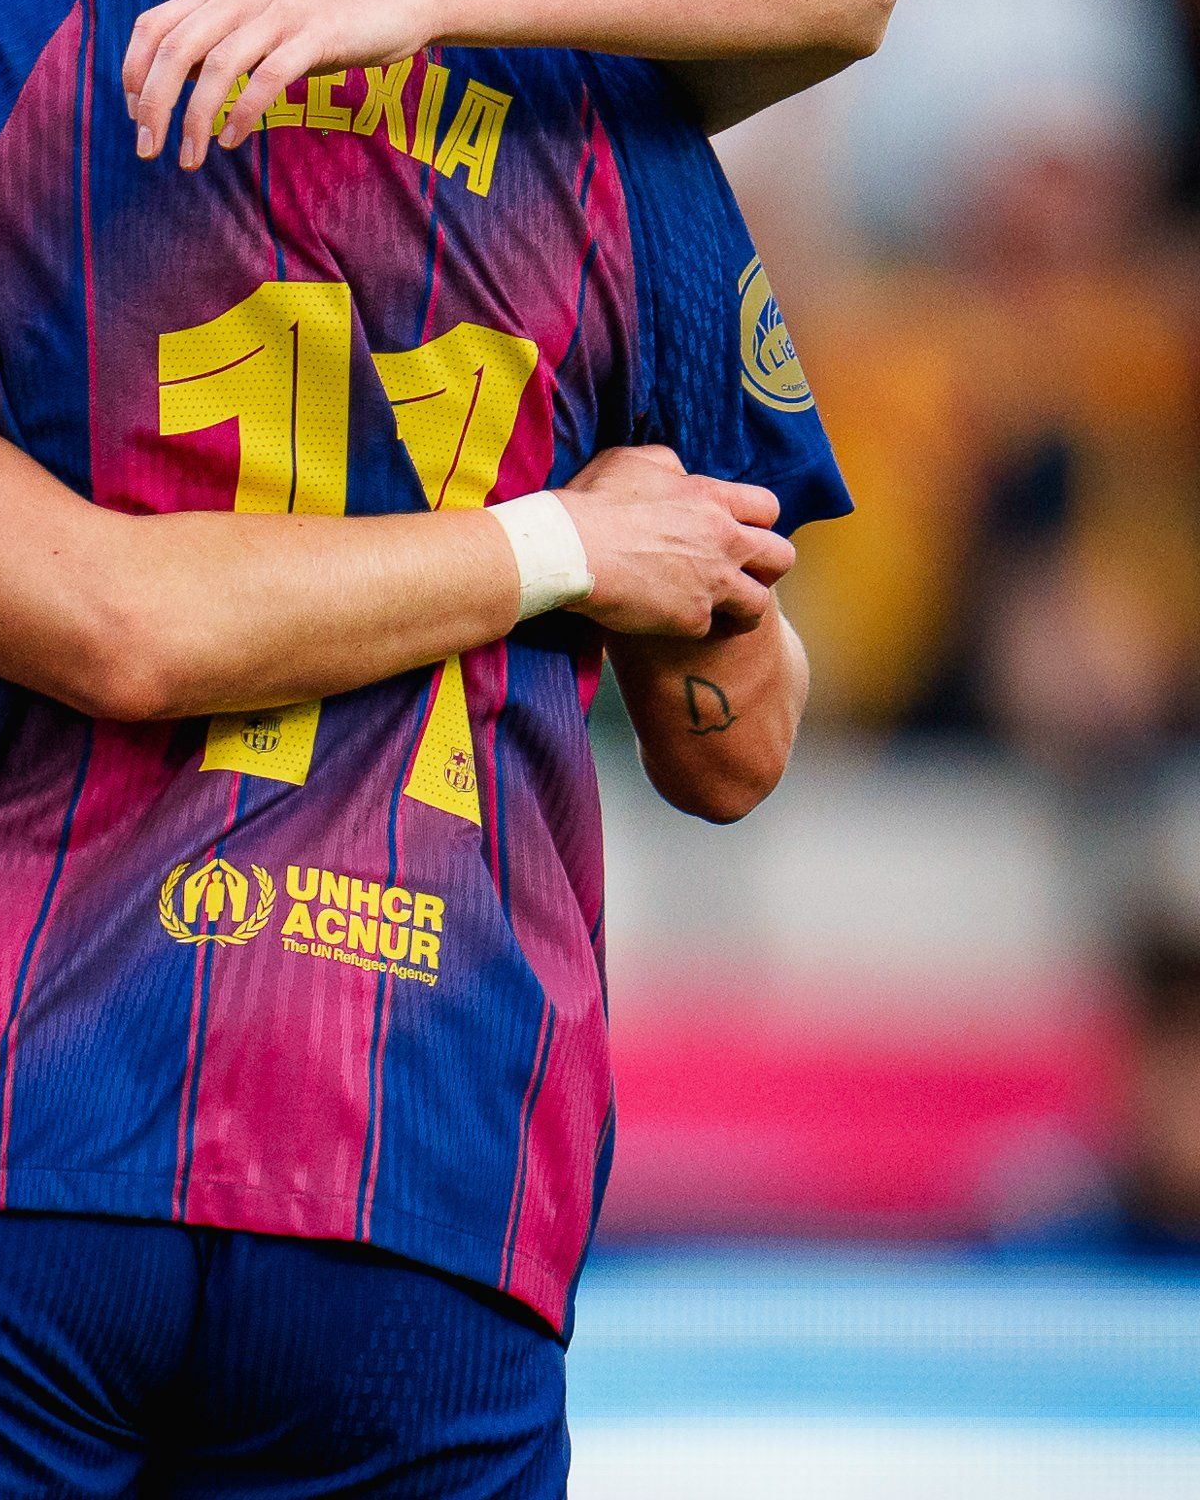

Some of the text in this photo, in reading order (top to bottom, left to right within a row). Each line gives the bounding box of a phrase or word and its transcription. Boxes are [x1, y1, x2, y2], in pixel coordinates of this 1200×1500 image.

[159, 281, 539, 827] 11
[286, 864, 446, 932] UNHCR
[280, 902, 441, 970] ACNUR
[281, 937, 439, 987] The UN Refugee Agency
